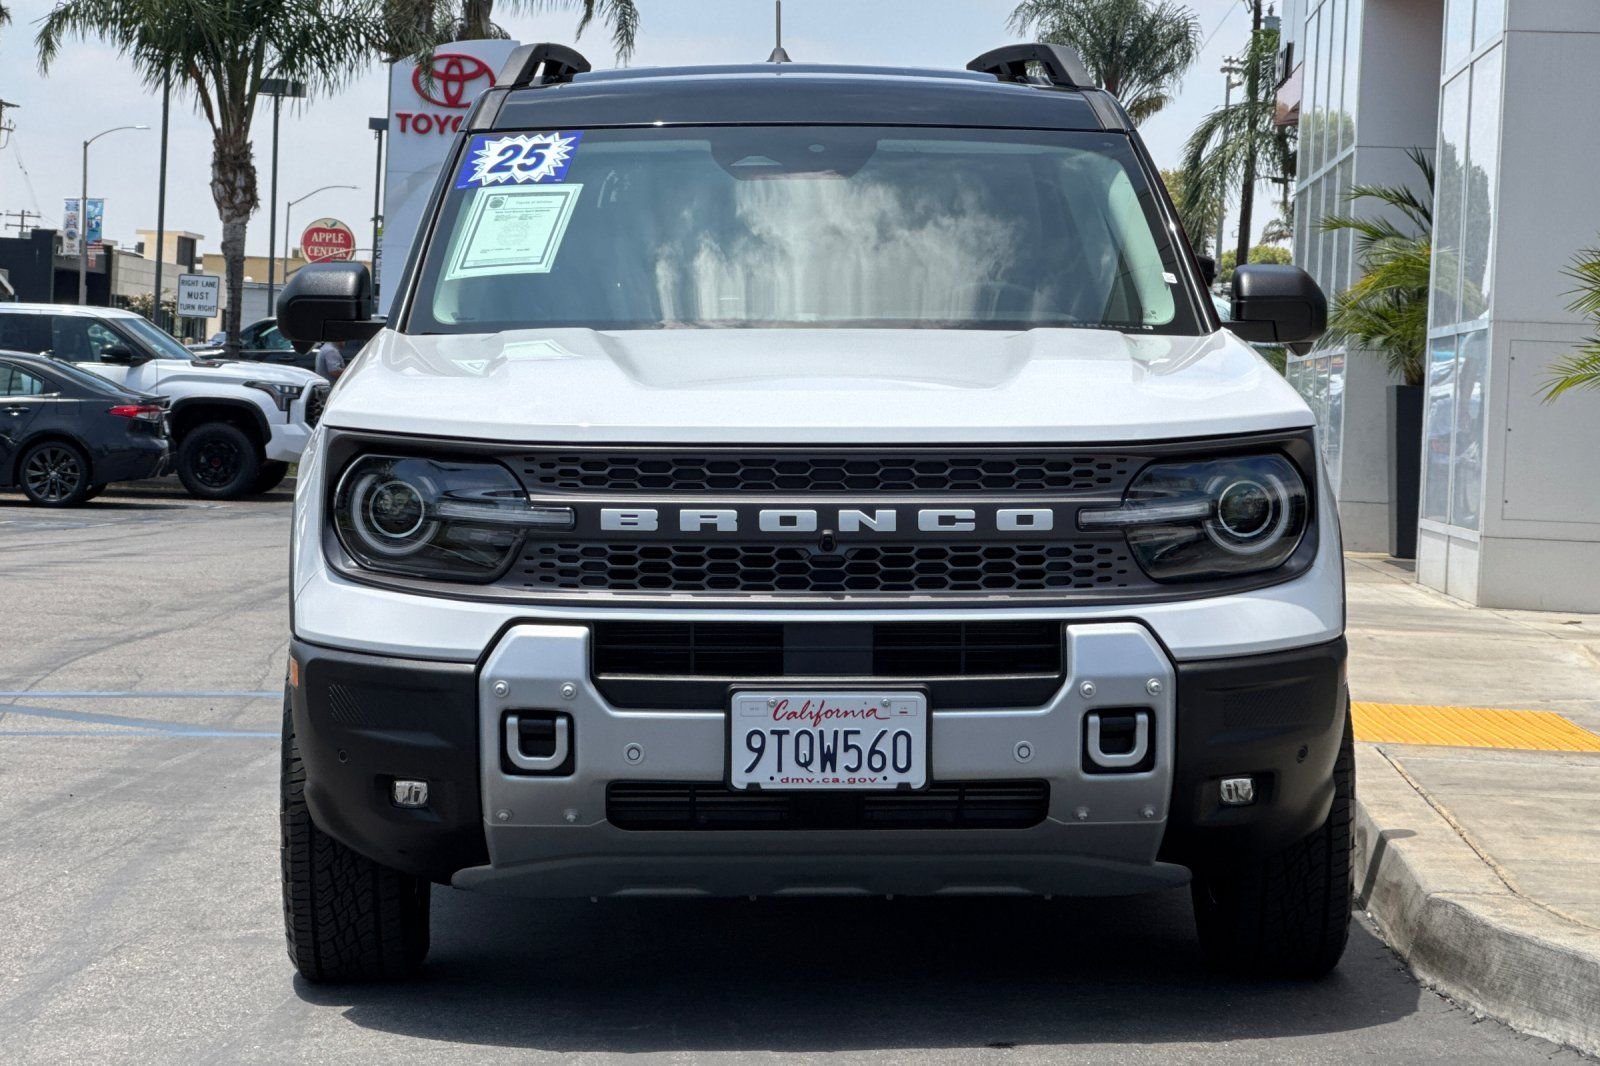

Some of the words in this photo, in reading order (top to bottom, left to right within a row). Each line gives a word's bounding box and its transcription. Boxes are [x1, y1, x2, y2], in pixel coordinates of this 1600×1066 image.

[486, 143, 552, 174] 25
[311, 232, 345, 244] APPLE
[307, 245, 347, 257] CENTER
[181, 279, 199, 287] RIGHT
[201, 280, 217, 288] LANE
[187, 291, 209, 300] MUST
[198, 304, 216, 312] RIGHT
[600, 508, 1054, 531] BRONCO
[772, 699, 890, 727] California
[744, 729, 912, 773] 9TQW560
[780, 776, 878, 784] dmv.ca.gov
